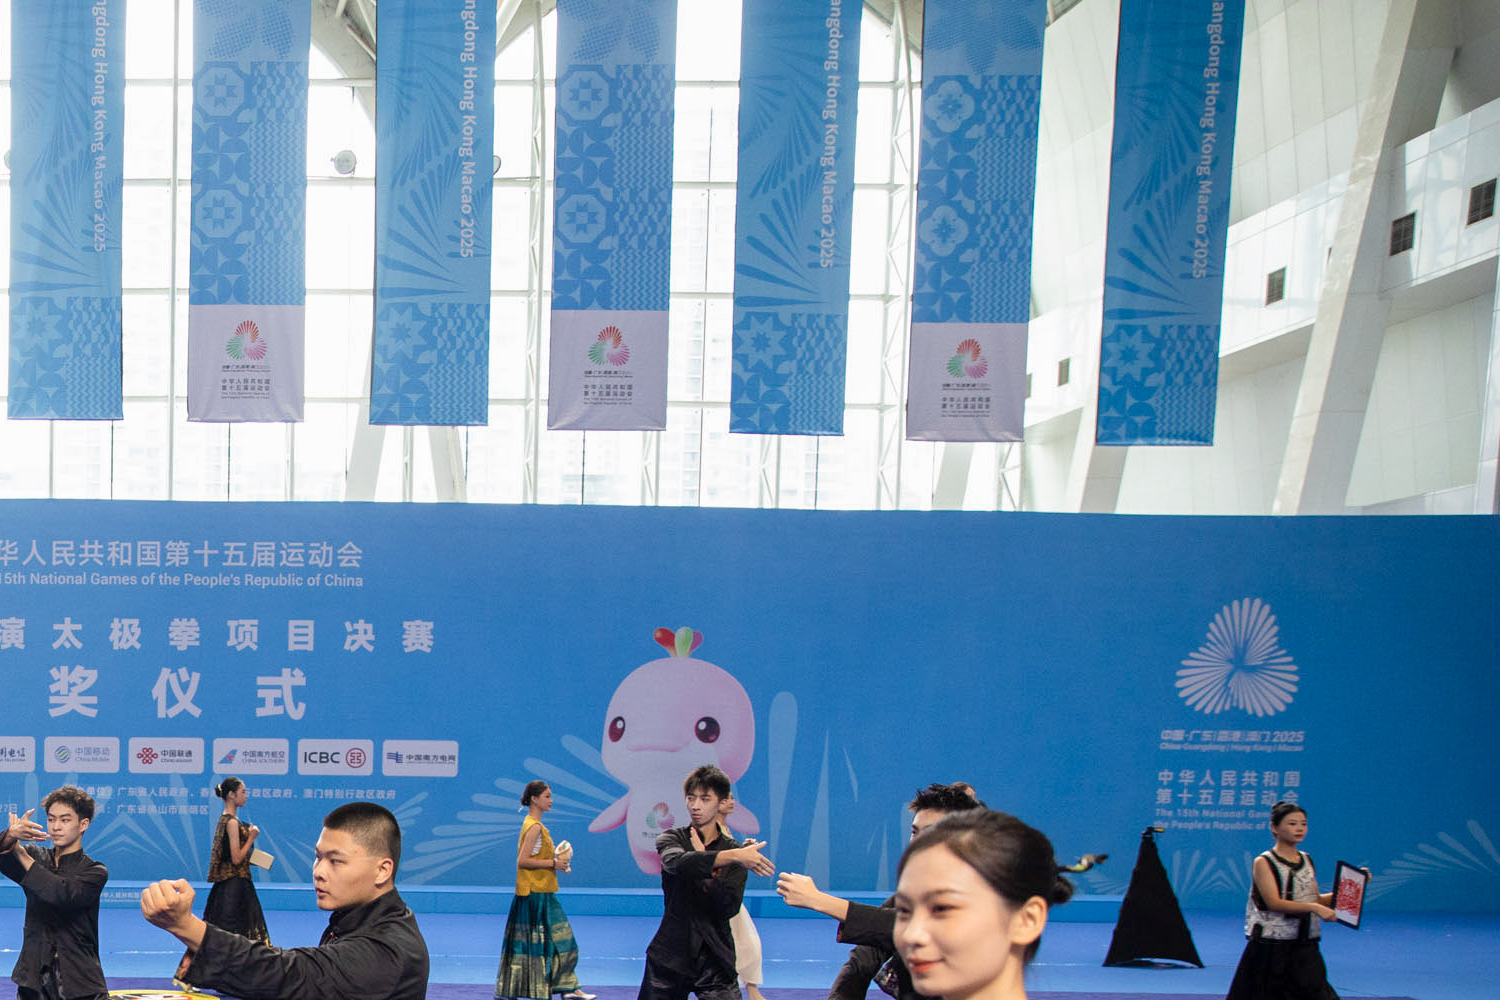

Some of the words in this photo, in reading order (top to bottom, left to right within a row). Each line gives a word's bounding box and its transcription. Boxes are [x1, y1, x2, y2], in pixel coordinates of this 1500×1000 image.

[91, 62, 107, 106] Hong
[460, 67, 477, 111] Hong
[822, 75, 840, 119] Hong
[1201, 82, 1219, 128] Hong
[91, 110, 107, 152] Kong
[459, 115, 476, 157] Kong
[821, 124, 838, 166] Kong
[1197, 132, 1215, 176] Kong
[94, 157, 106, 209] Macao
[462, 161, 475, 213] Macao
[821, 171, 836, 224] Macao
[1196, 180, 1212, 234] Macao
[94, 214, 106, 252] 2025
[461, 218, 474, 257] 2025
[820, 228, 834, 268] 2025
[1193, 238, 1208, 278] 2025
[30, 572, 86, 585] National
[90, 572, 137, 585] Games
[141, 573, 156, 585] of
[159, 573, 180, 586] the
[184, 573, 240, 588] People's
[245, 574, 303, 588] Republic
[307, 574, 321, 587] of
[325, 574, 363, 587] China
[161, 749, 192, 757] 中国联通
[304, 752, 340, 763] ICBC
[1156, 788, 1299, 806] 第十五届运动会
[1158, 769, 1300, 787] 中华人民共和国
